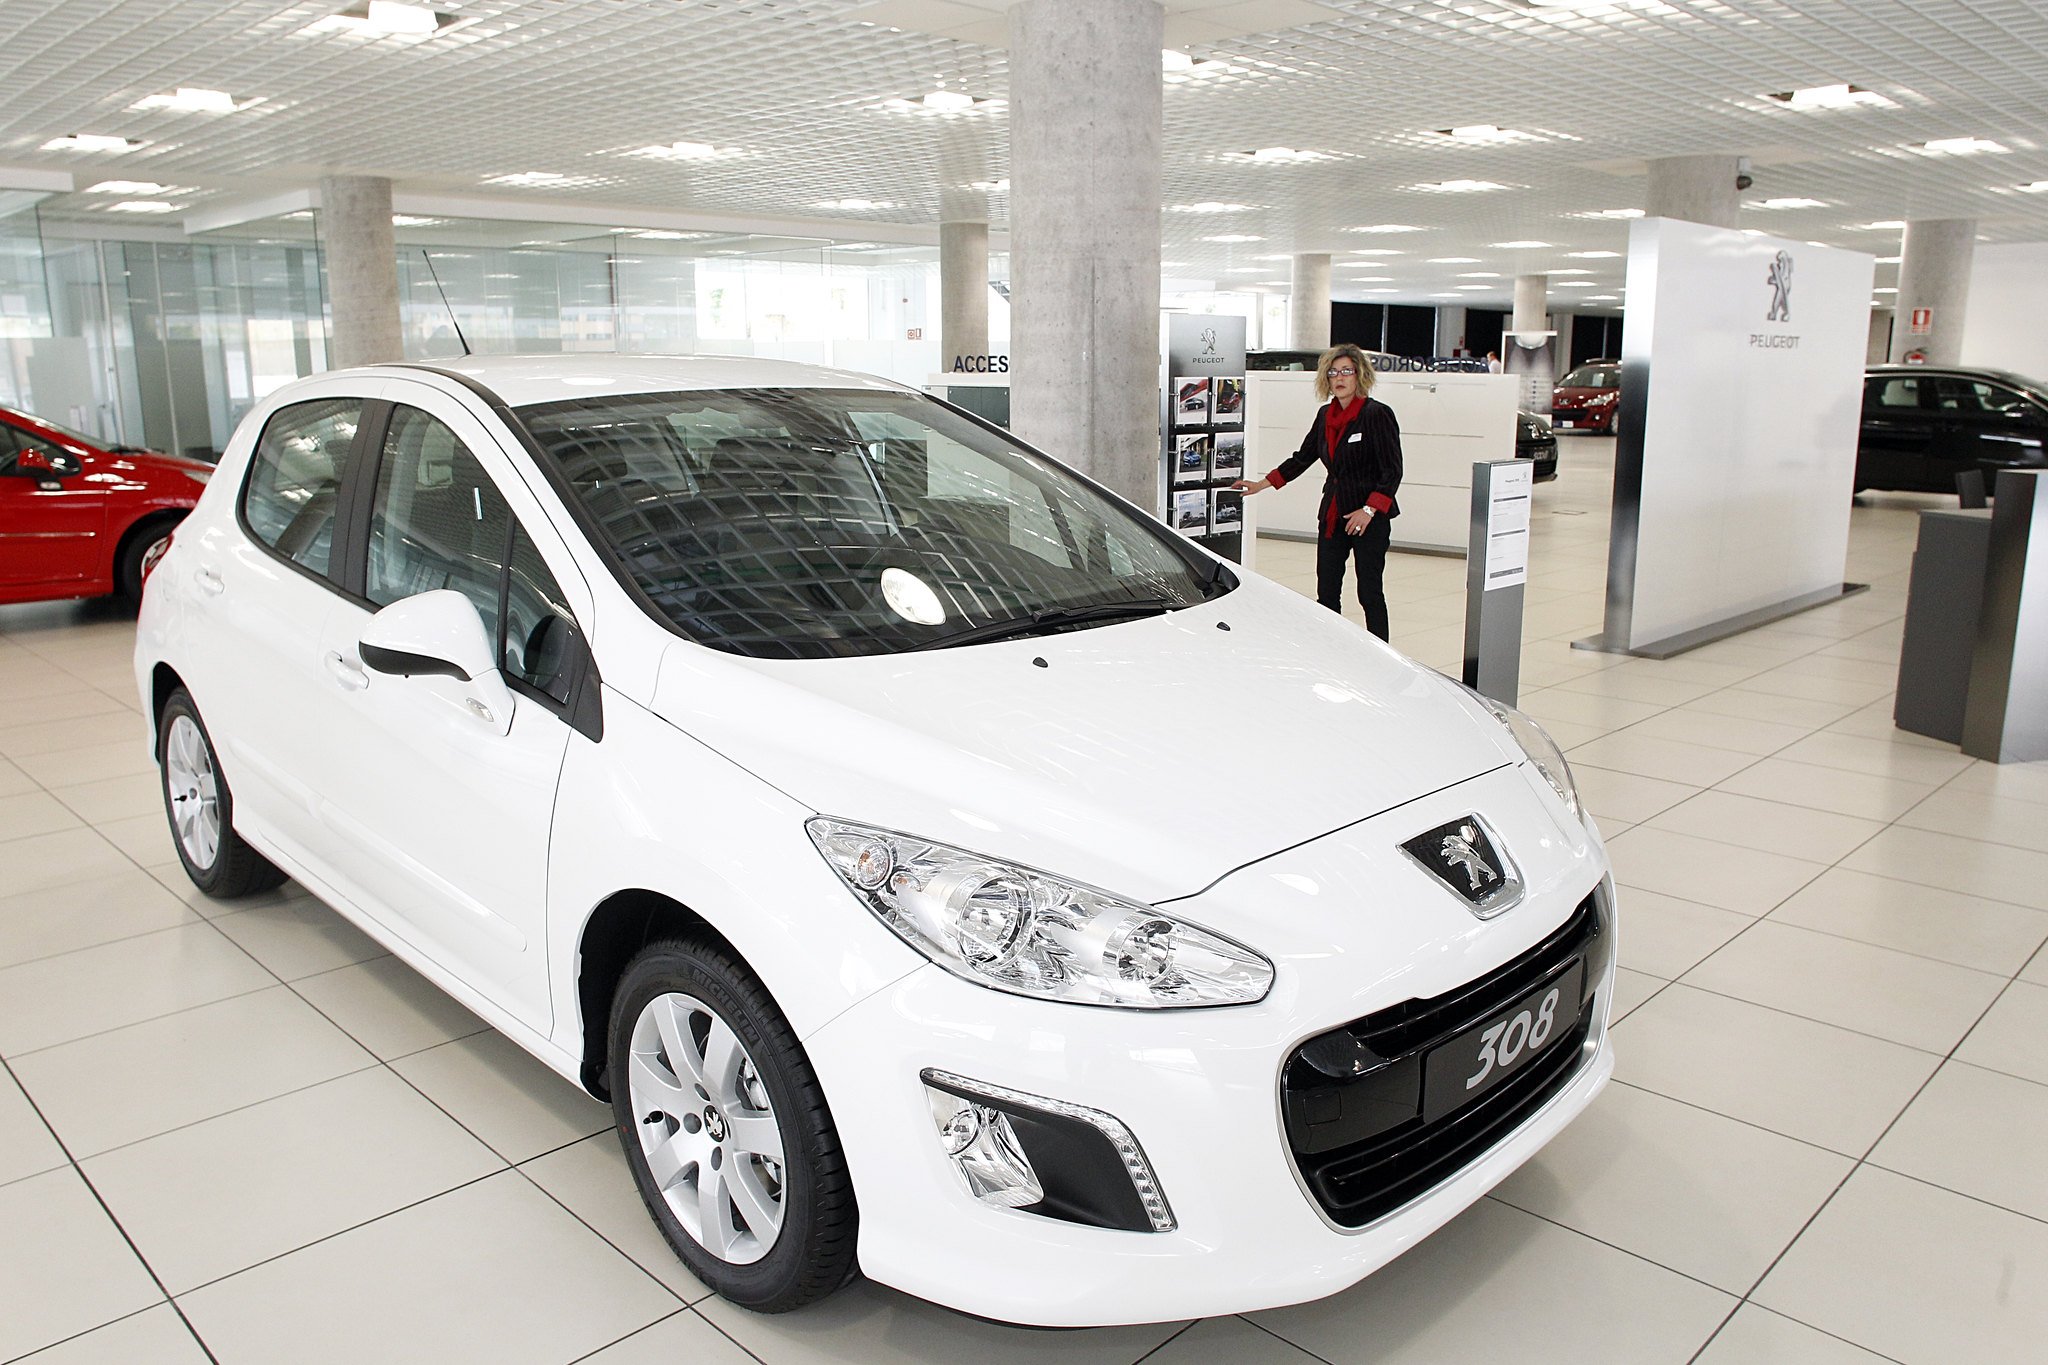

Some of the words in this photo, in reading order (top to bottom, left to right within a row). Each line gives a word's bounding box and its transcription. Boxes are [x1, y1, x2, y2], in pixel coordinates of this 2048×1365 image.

[1750, 334, 1800, 349] PEUGEOT
[691, 968, 760, 1042] MICHELIN
[1466, 988, 1559, 1090] 308
